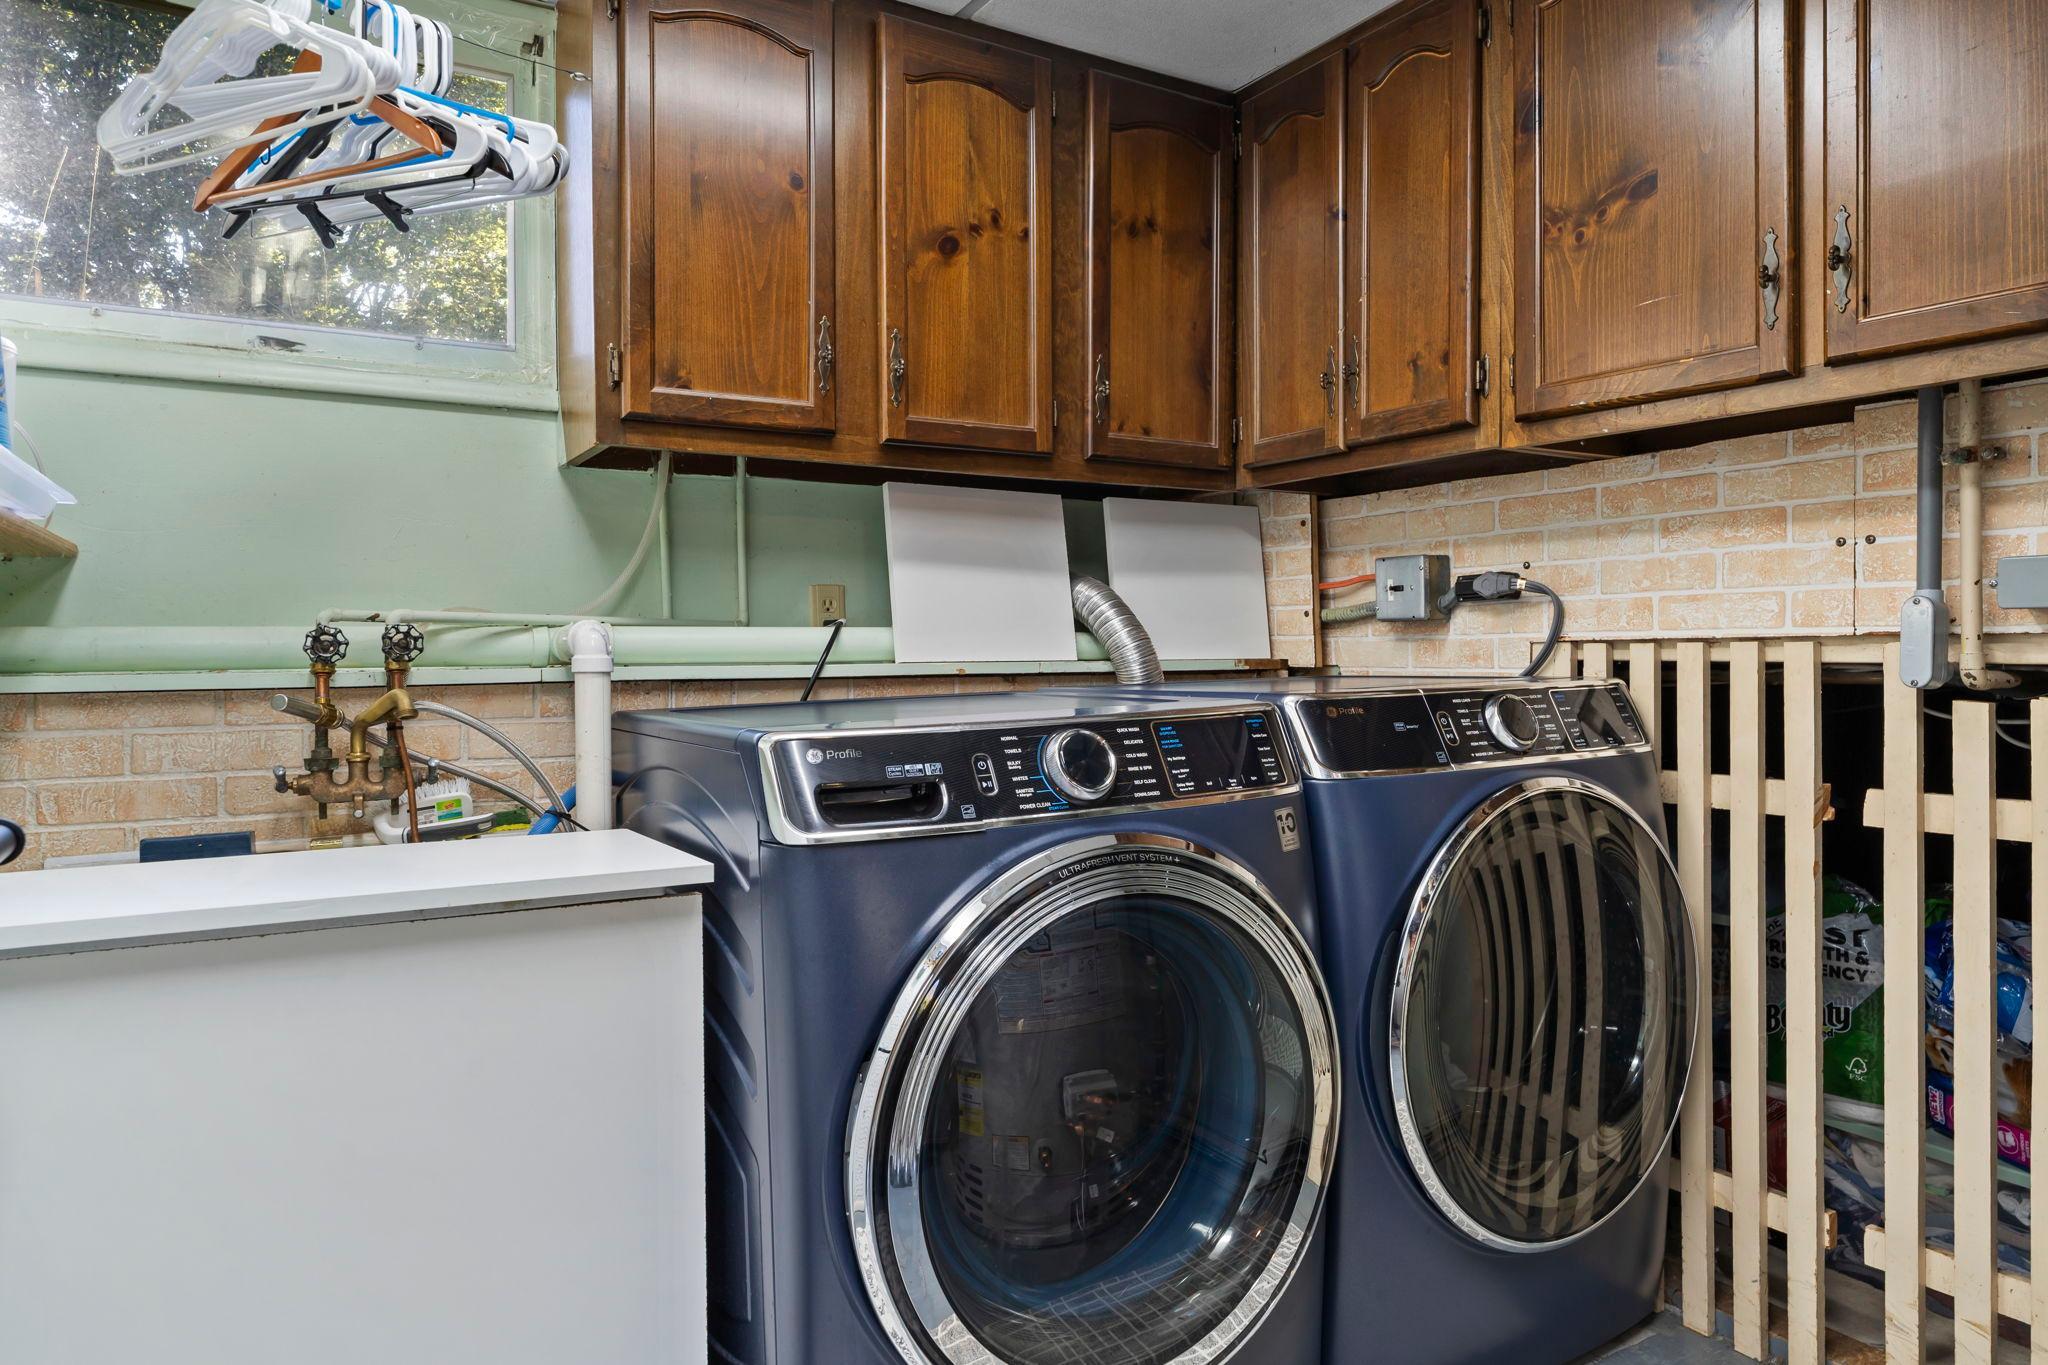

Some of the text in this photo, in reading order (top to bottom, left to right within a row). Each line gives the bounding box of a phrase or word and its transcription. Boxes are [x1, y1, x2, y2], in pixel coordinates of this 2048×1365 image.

[1338, 707, 1364, 715] Profile
[826, 748, 863, 760] Profile
[1134, 790, 1160, 798] DOWNLOADED
[1277, 812, 1296, 834] 10
[1058, 855, 1115, 879] ULTRAFRESH
[1116, 853, 1138, 863] VENT
[1929, 1086, 1940, 1122] NEW!
